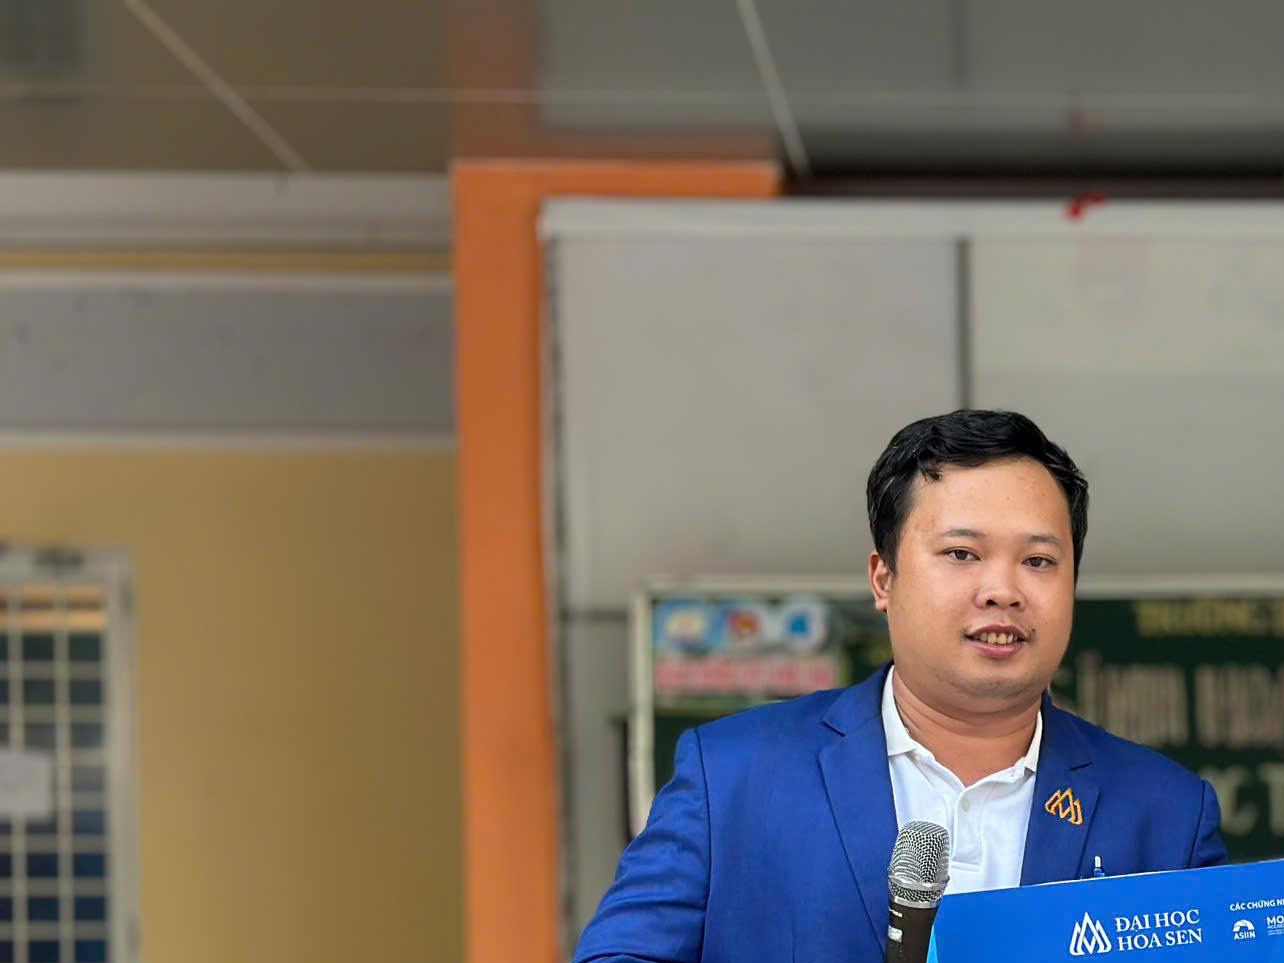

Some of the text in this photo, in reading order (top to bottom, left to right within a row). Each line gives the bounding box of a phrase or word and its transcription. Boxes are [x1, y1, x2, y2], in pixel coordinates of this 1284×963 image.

[1229, 902, 1246, 911] CÁC
[1114, 908, 1201, 933] ĐẠI HỌC
[1117, 928, 1203, 952] HOA SEN
[1233, 930, 1256, 940] ASIIN
